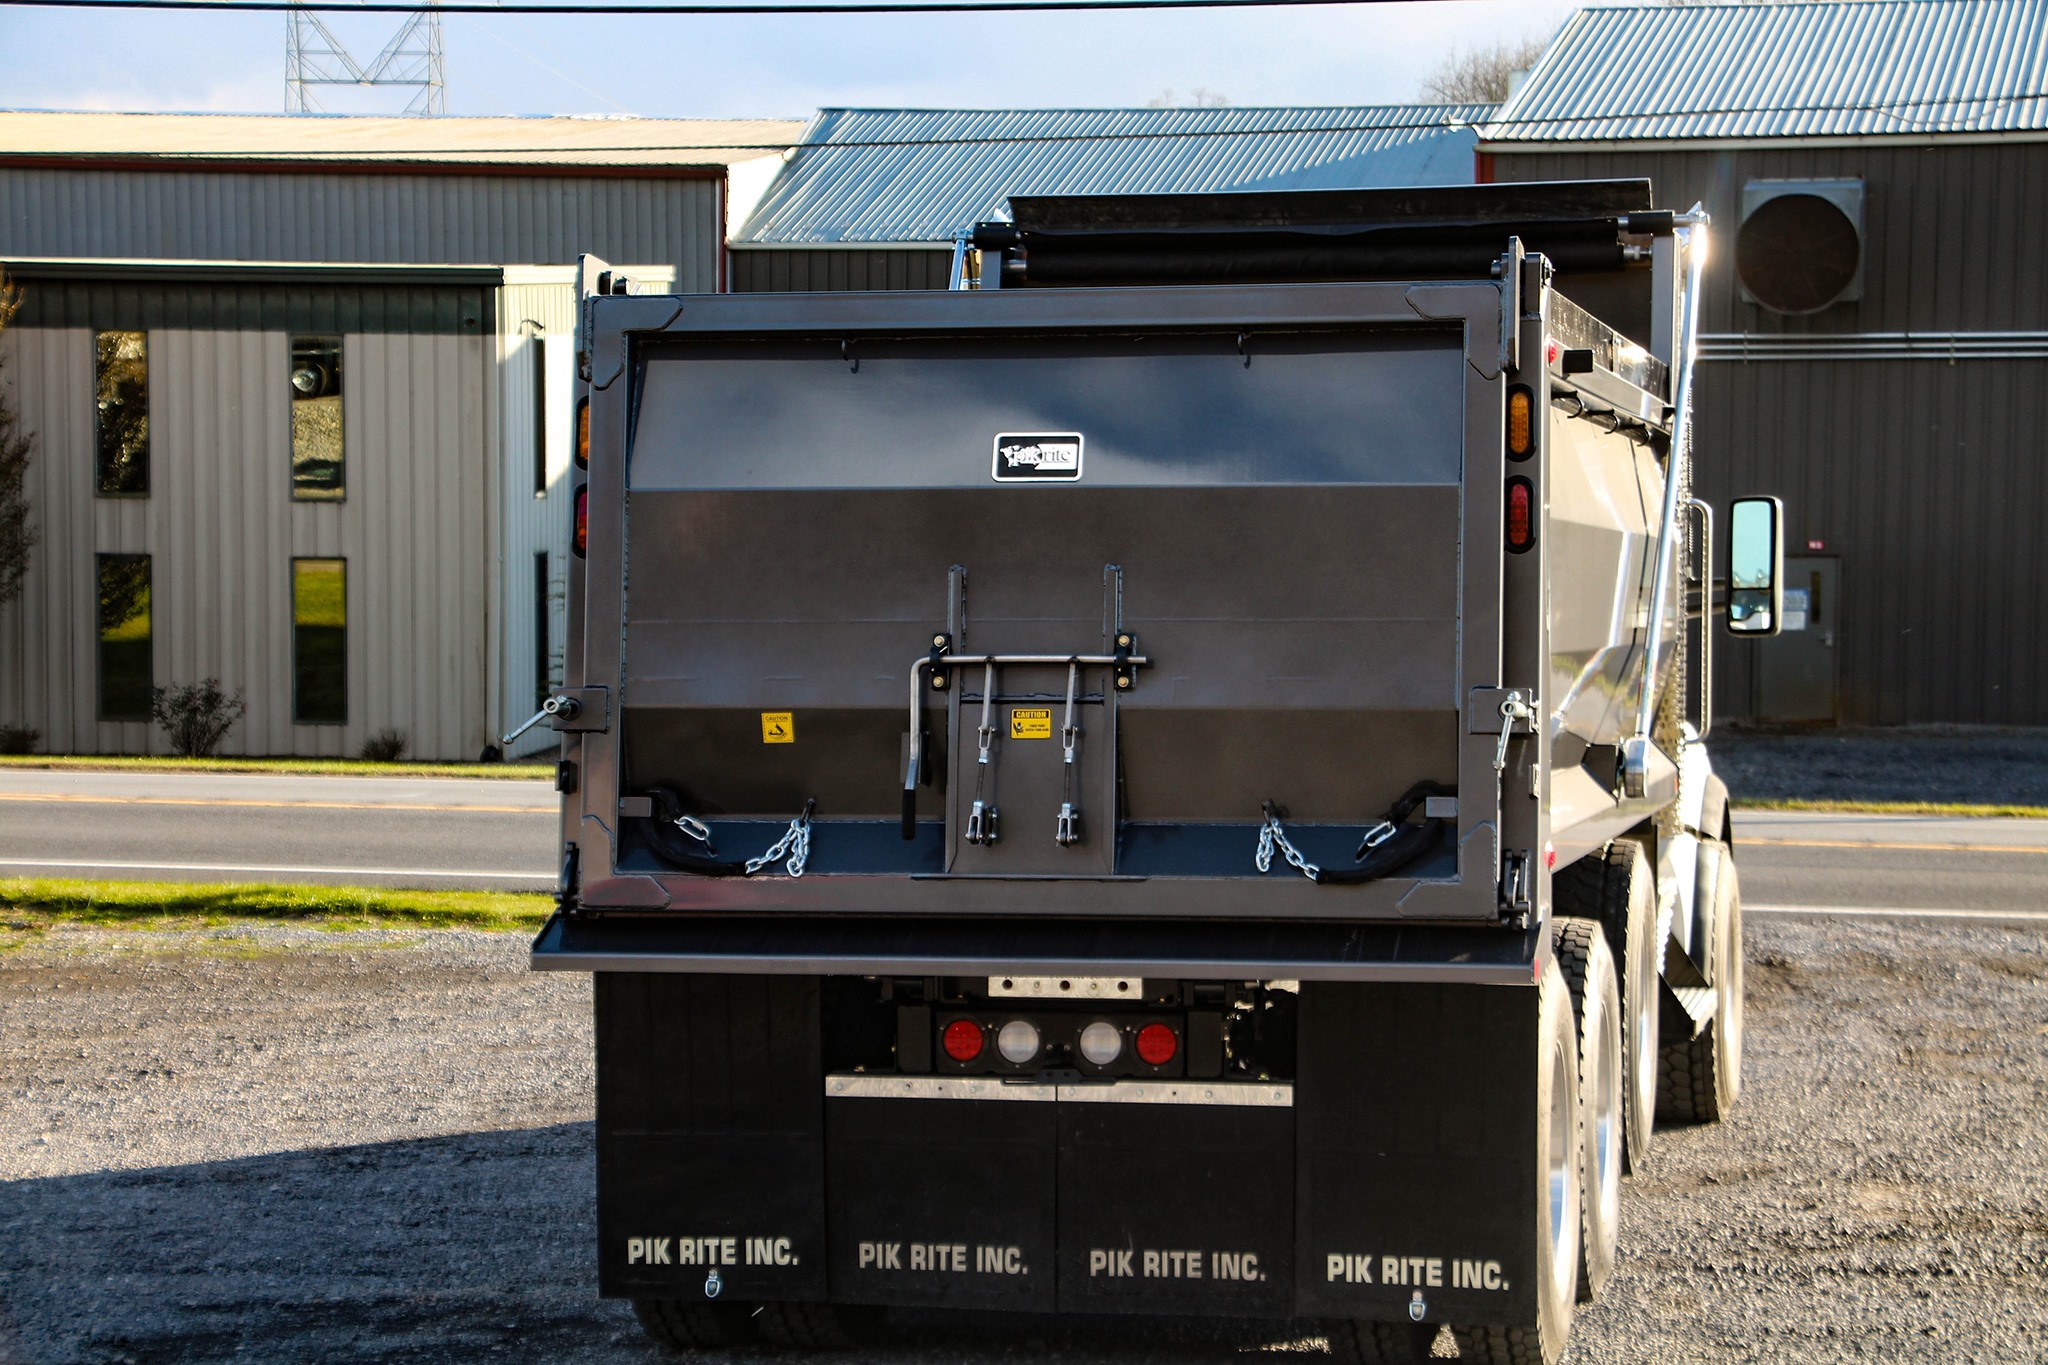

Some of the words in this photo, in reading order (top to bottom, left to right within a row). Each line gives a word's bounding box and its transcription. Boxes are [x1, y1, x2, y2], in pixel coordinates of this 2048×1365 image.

[628, 1238, 670, 1265] PIK
[680, 1238, 736, 1265] RITE
[745, 1238, 799, 1265] INC.
[859, 1243, 901, 1269] PIK
[911, 1244, 967, 1271] RITE
[976, 1247, 1028, 1275] INC.
[1090, 1250, 1134, 1277] PIK
[1144, 1251, 1202, 1278] RITE
[1212, 1253, 1266, 1281] INC.
[1327, 1254, 1372, 1283] PIK
[1382, 1256, 1442, 1287] RITE
[1452, 1259, 1509, 1290] INC.
